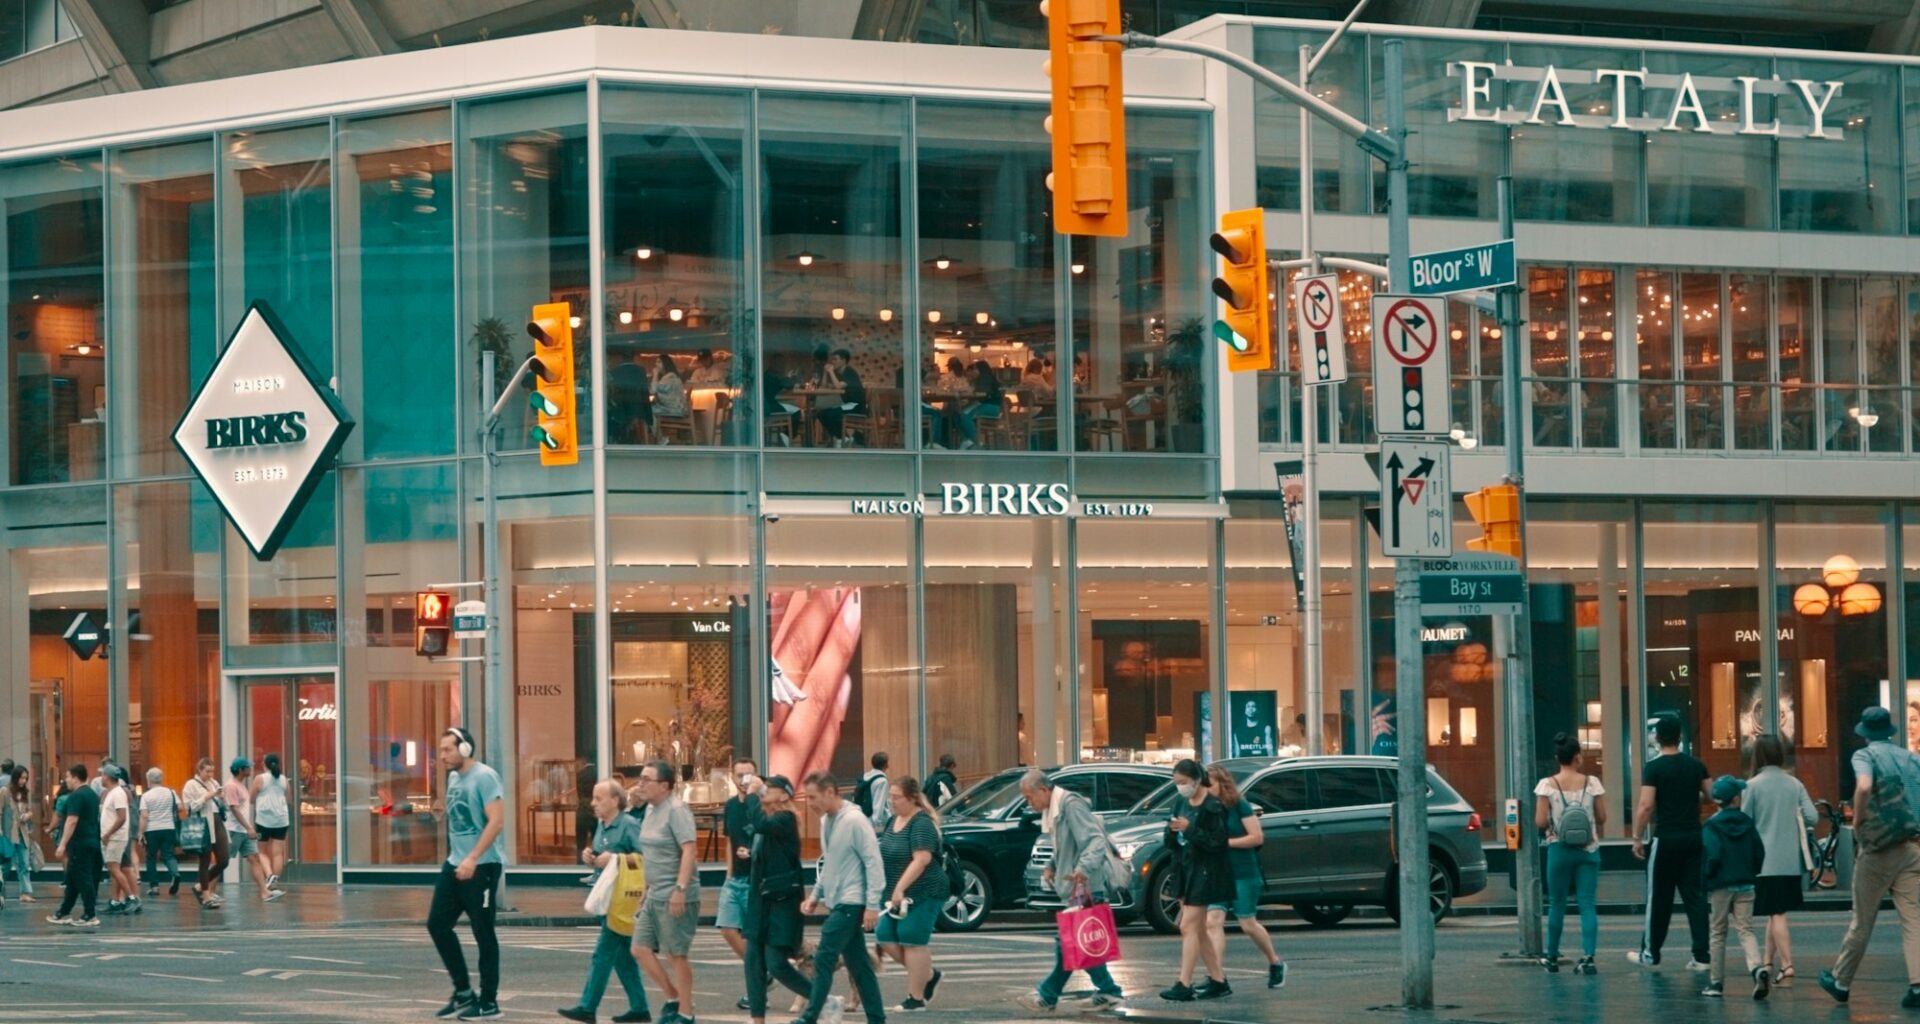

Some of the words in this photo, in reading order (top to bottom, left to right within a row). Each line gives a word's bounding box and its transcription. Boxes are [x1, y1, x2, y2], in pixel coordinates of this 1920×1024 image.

[1459, 61, 1844, 138] EATALY
[1413, 258, 1462, 287] Bloor
[1464, 252, 1474, 267] St
[1477, 248, 1492, 277] W
[233, 379, 280, 392] MAISON
[205, 411, 307, 449] BIRKS
[234, 470, 256, 482] EST.
[853, 499, 924, 515] MAISON
[941, 482, 1069, 515] BIRKS
[1084, 503, 1115, 516] EST.
[1119, 503, 1153, 516] 1879
[1450, 577, 1477, 600] Bay
[1480, 581, 1491, 595] St
[1458, 605, 1481, 614] 1170
[692, 620, 711, 632] Van
[1735, 628, 1794, 642] PANAI
[1678, 664, 1688, 677] 12
[517, 684, 562, 696] BIRKS
